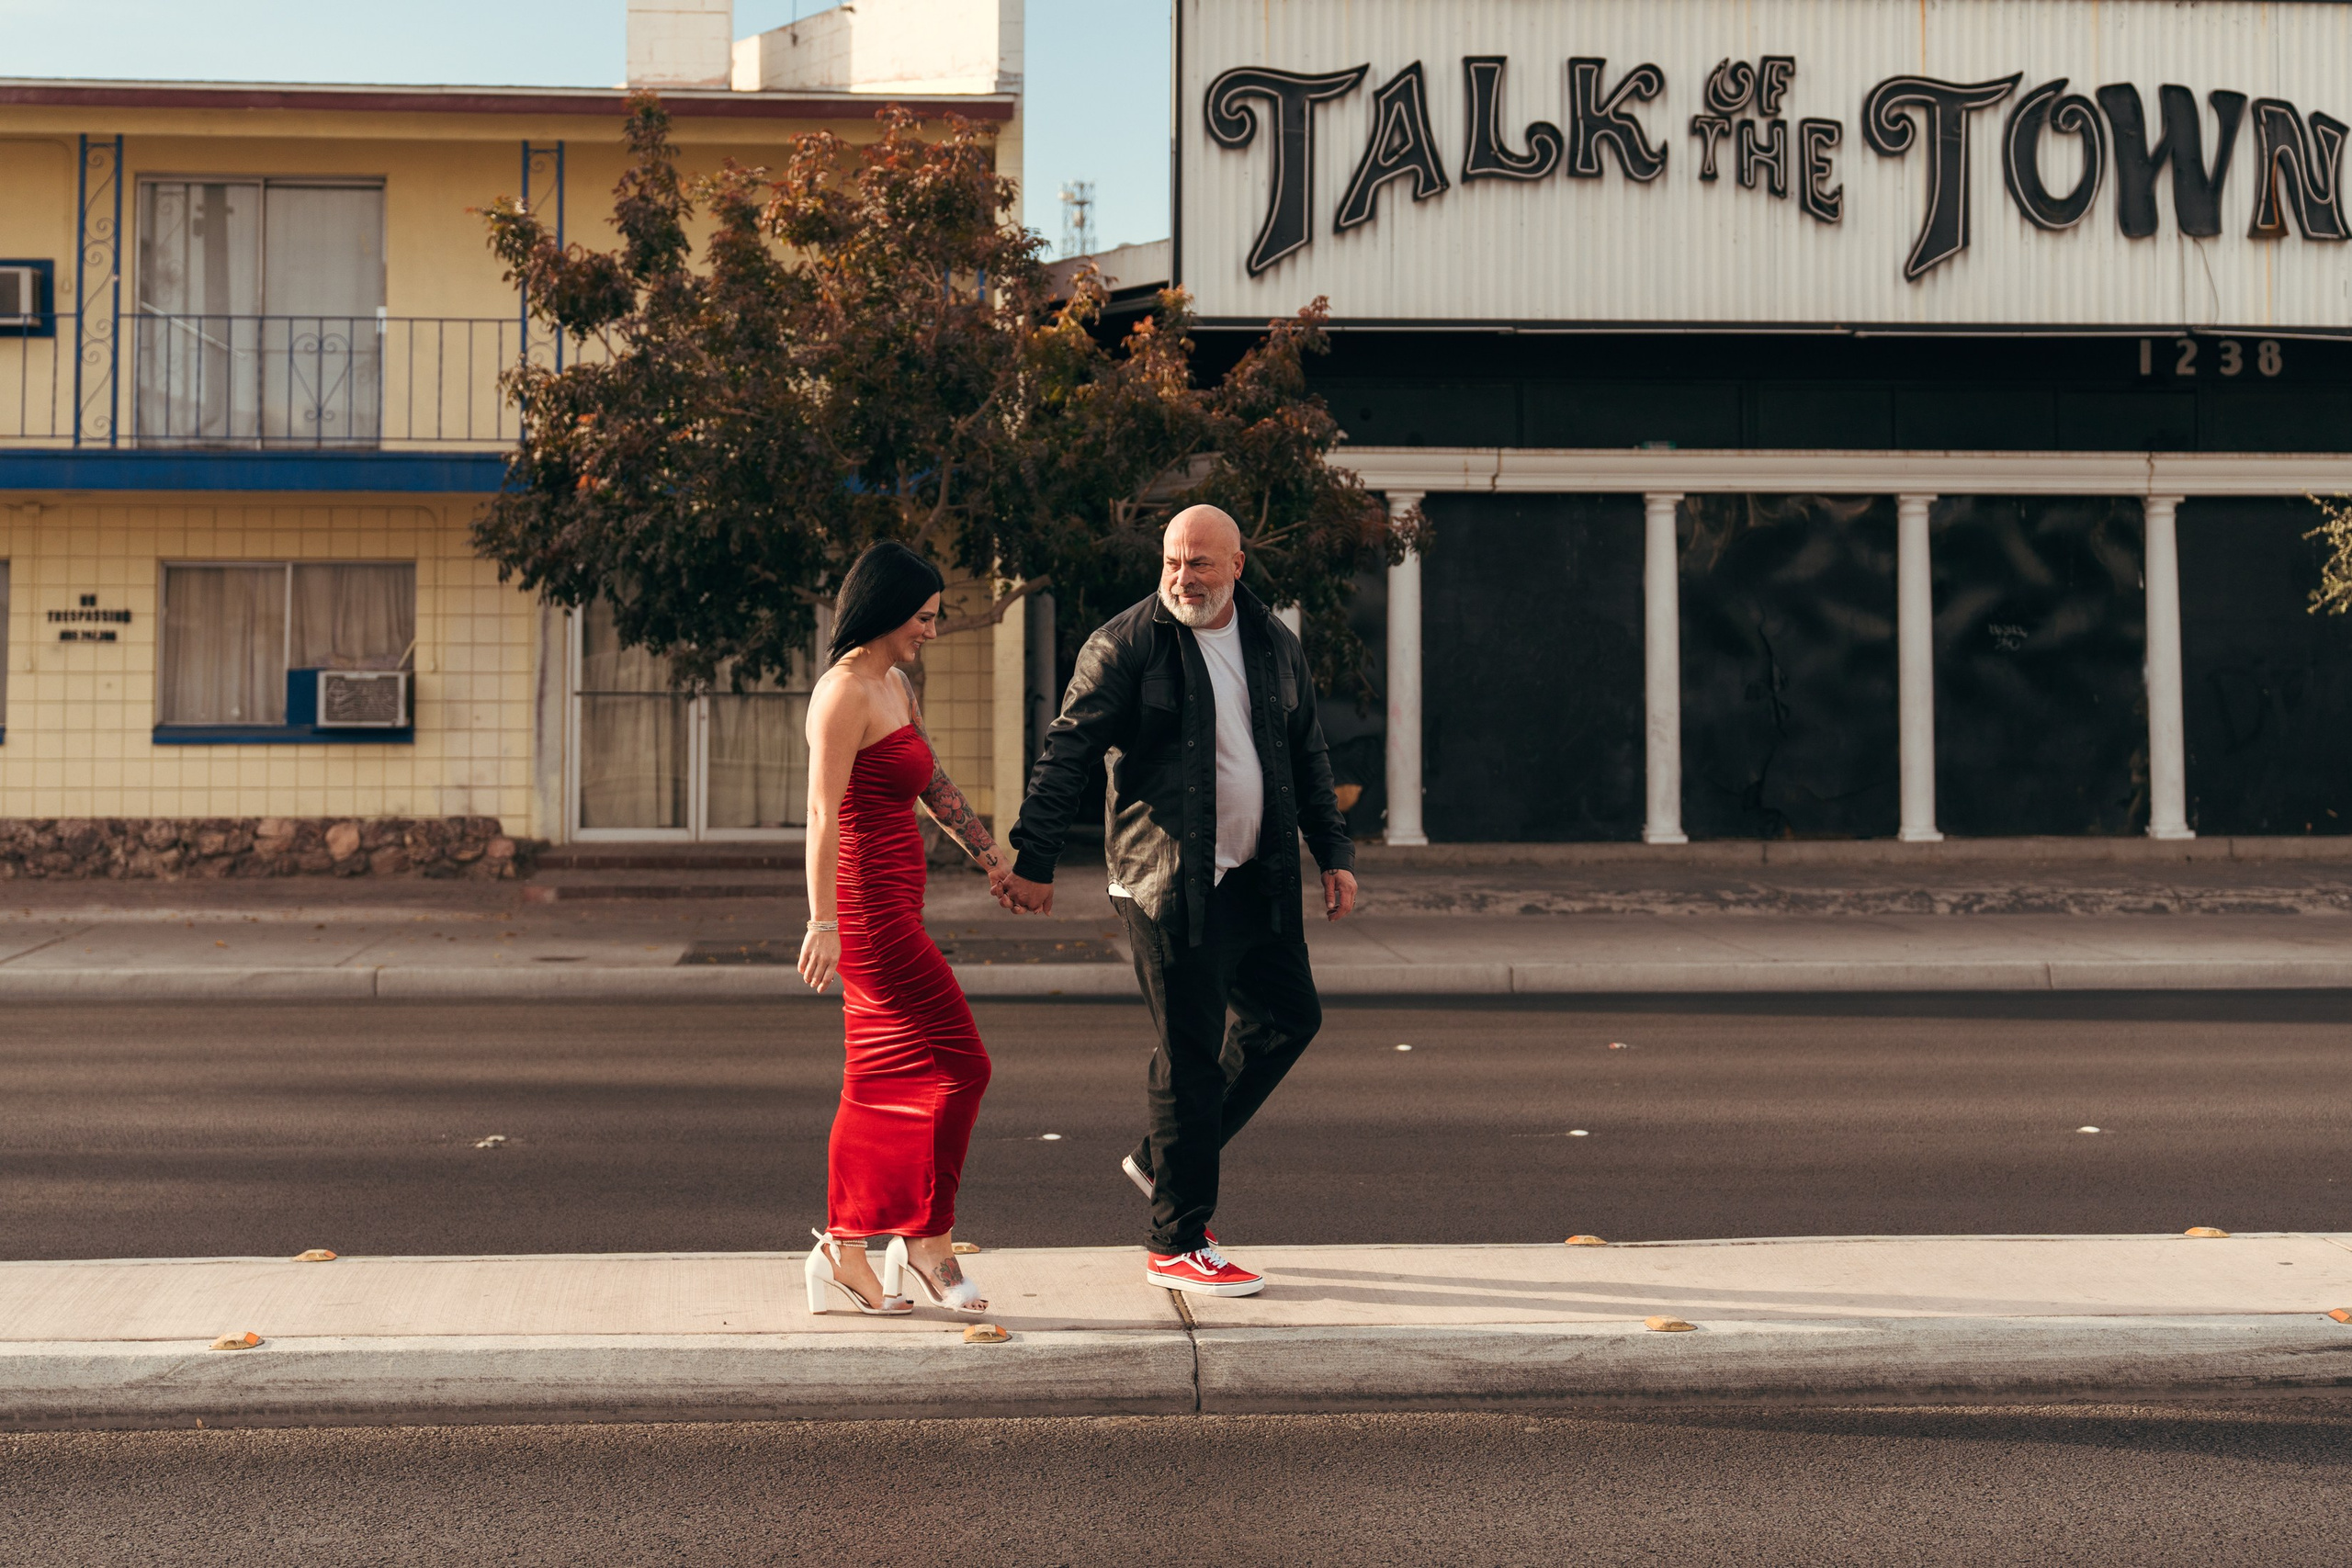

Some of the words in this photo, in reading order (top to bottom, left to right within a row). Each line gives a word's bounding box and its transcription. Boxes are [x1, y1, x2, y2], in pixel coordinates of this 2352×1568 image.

[1702, 55, 1796, 115] OF
[1204, 55, 1668, 278] TALK
[1690, 116, 1844, 224] THE
[1860, 71, 2352, 283] TOWN
[2139, 338, 2283, 378] 1238
